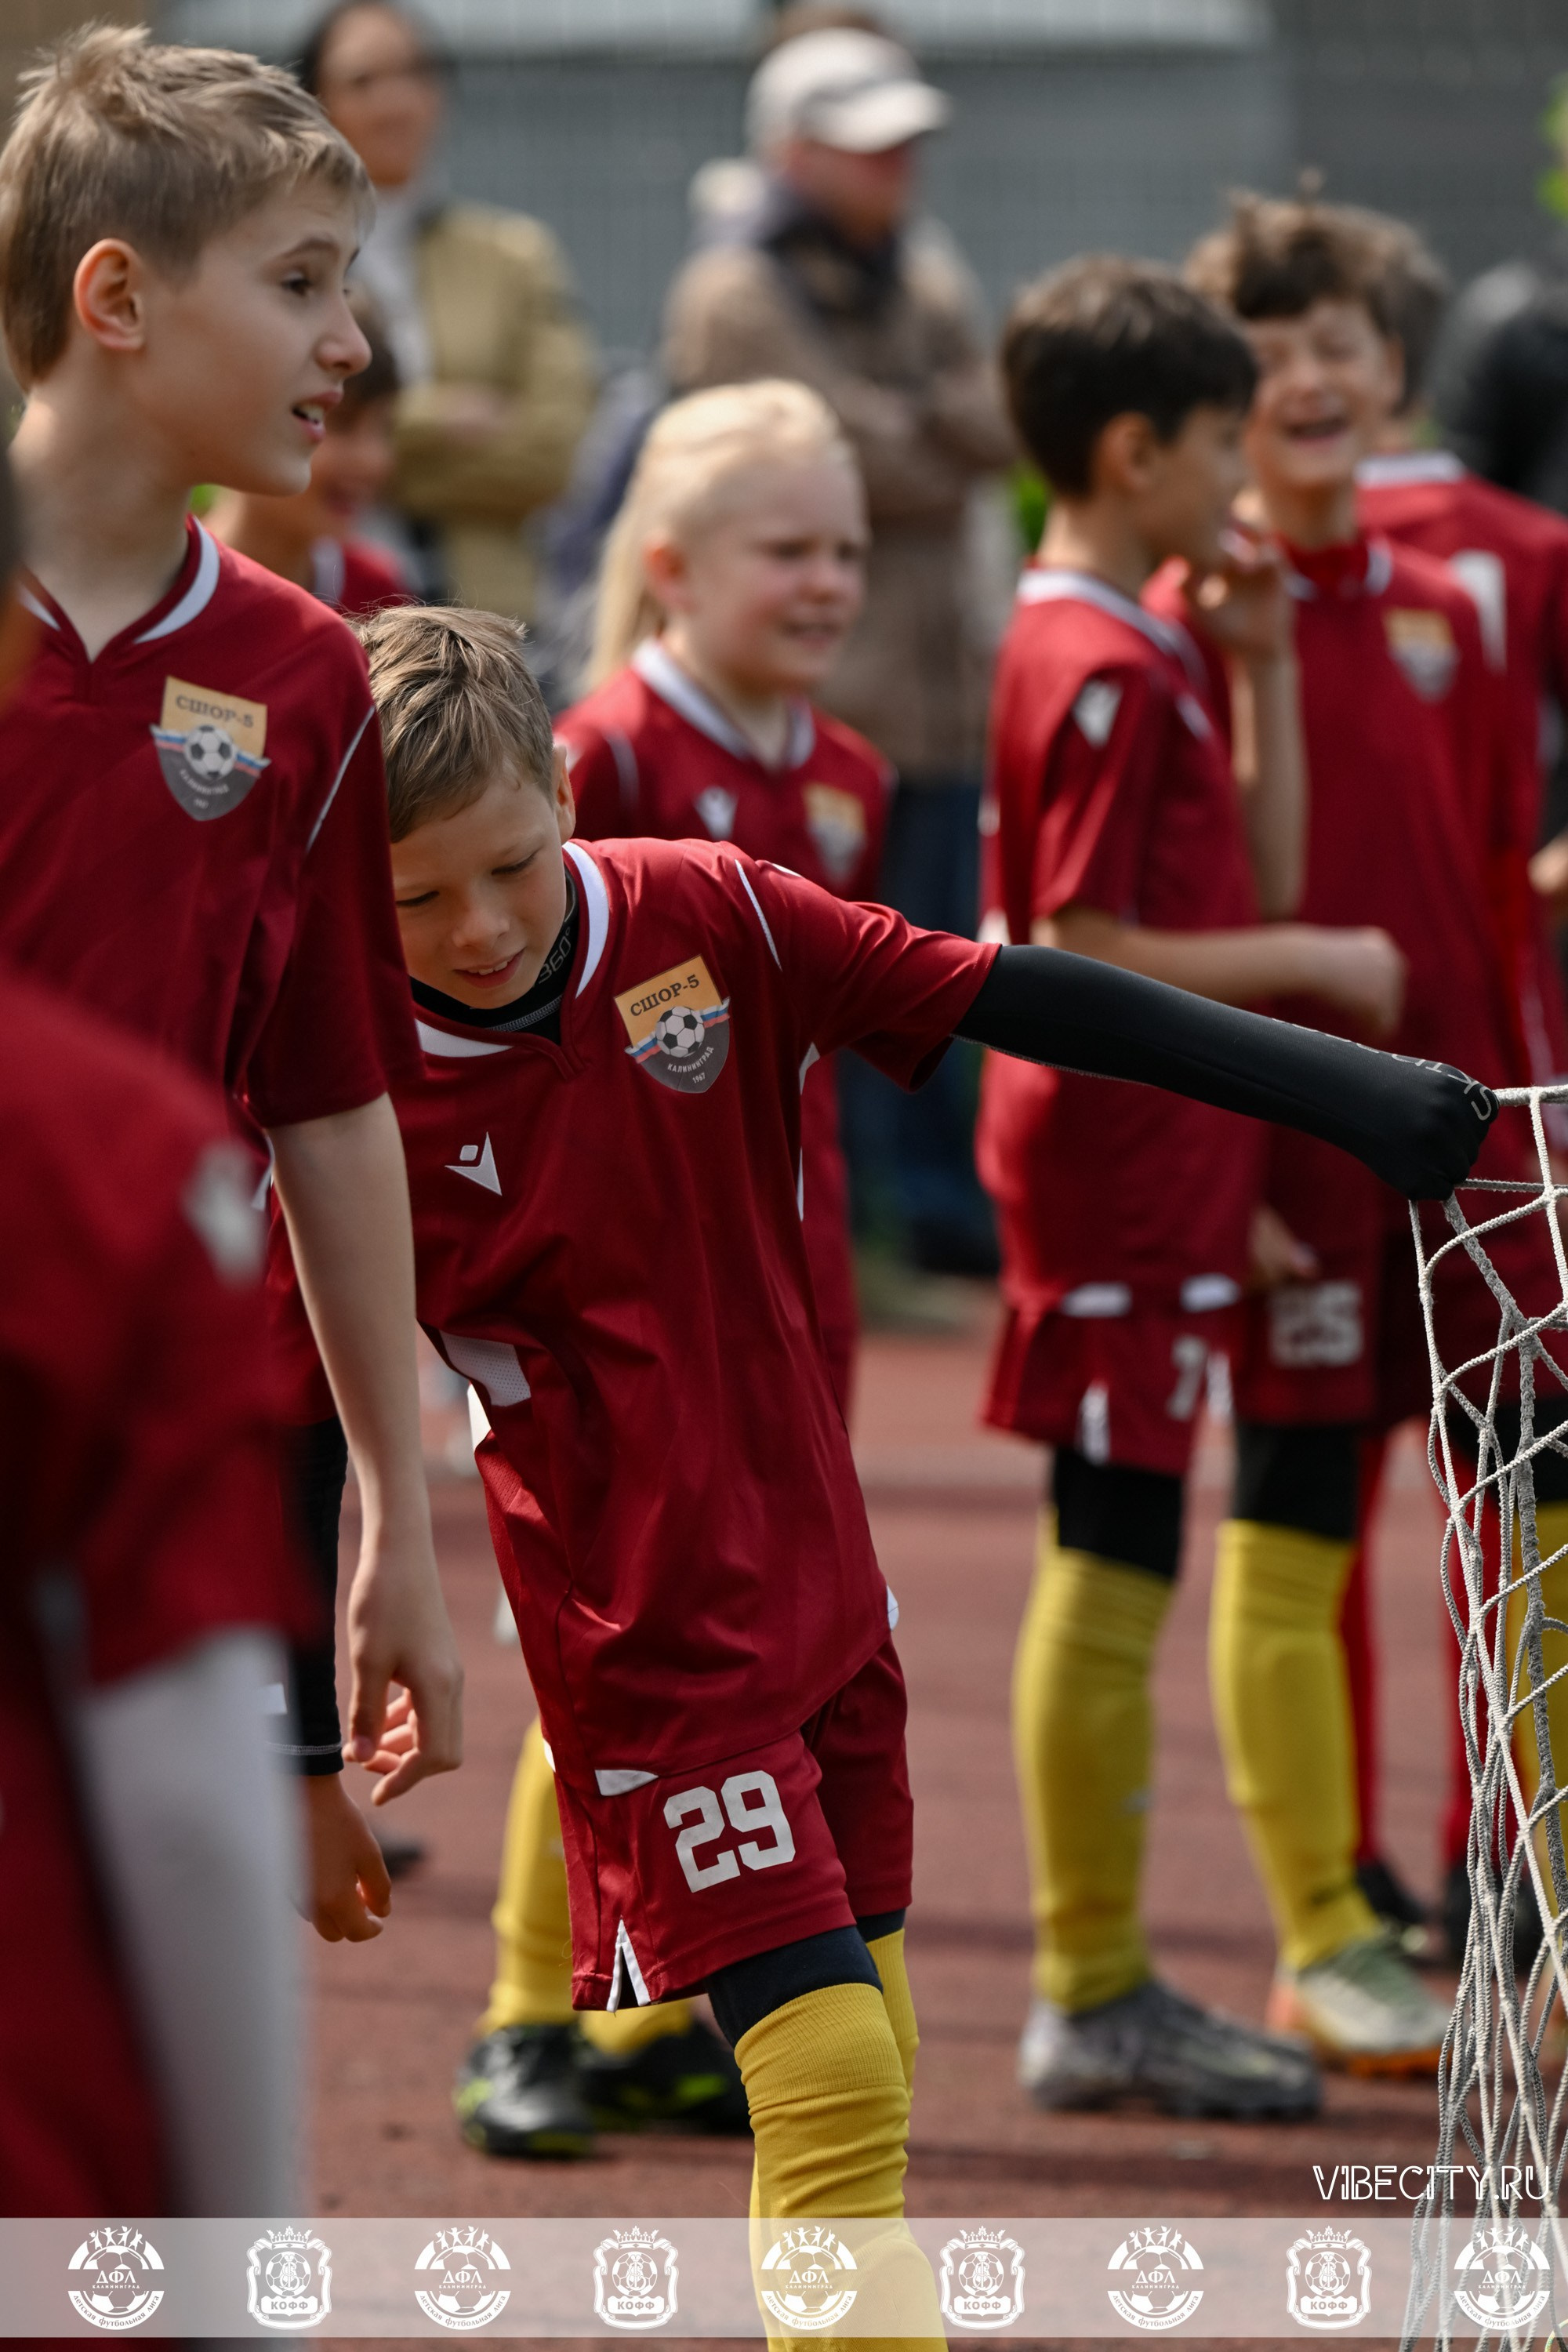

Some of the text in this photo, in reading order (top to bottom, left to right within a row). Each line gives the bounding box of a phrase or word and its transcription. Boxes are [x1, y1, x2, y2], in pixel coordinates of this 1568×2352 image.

[176, 694, 254, 728] СШОР-5
[630, 974, 700, 1017] СШОР-5
[667, 1046, 714, 1073] КАЛИНИНГРАД
[692, 1072, 706, 1084] 1967
[662, 1769, 797, 1893] 29
